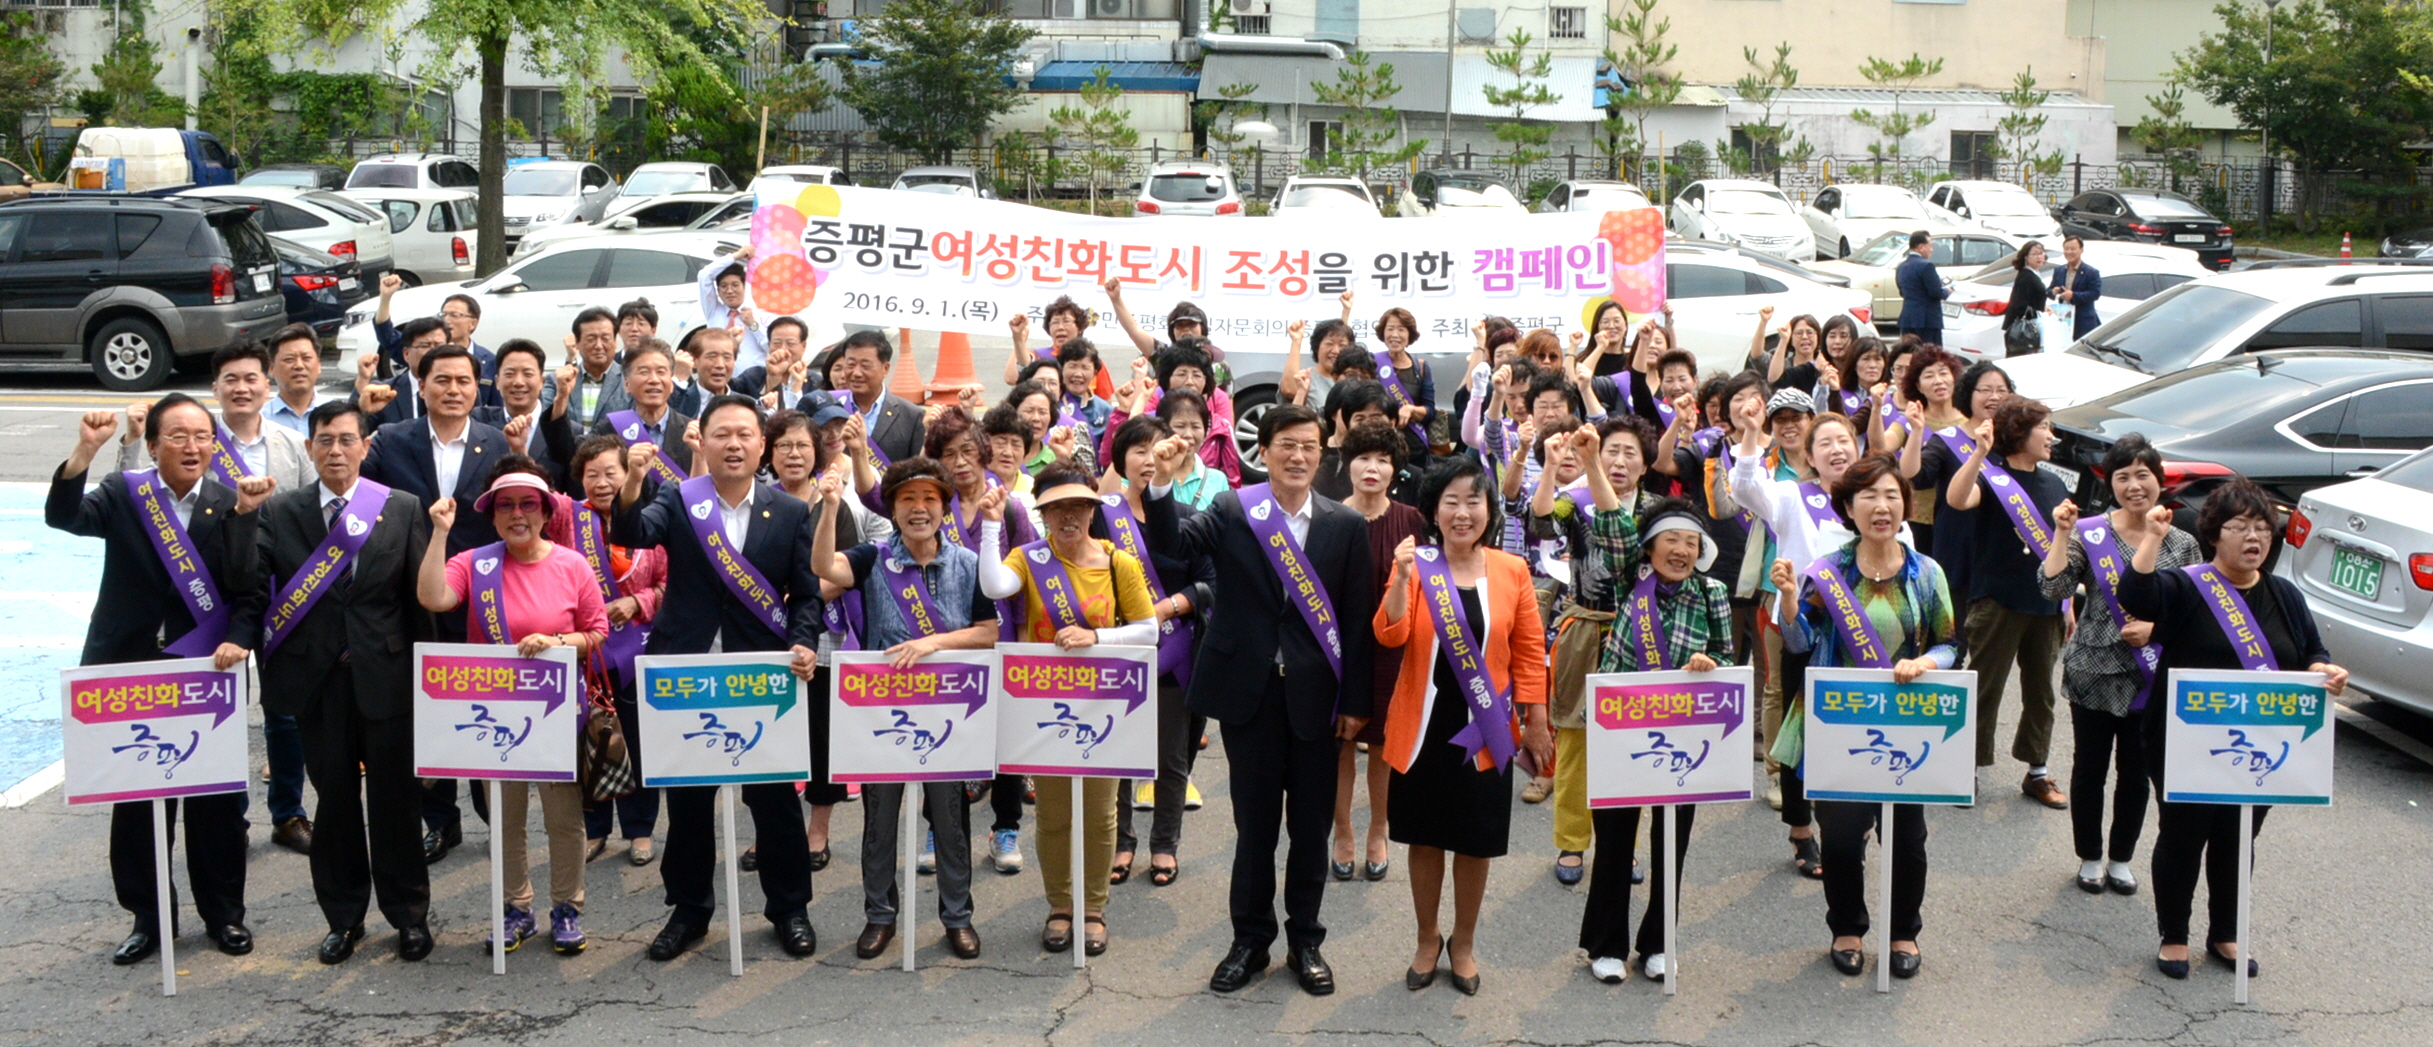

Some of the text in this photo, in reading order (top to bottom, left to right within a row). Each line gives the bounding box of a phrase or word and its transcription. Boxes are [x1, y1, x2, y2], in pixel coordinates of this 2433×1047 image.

[804, 219, 1607, 296] 증평군여성친화도시 조성을 위한 캠페인
[843, 292, 903, 313] 2016.
[912, 299, 930, 316] 9.
[1432, 317, 1468, 338] 주최
[137, 481, 214, 611] 여성친화도시 증평
[2009, 493, 2052, 553] 여성친화도
[271, 546, 344, 631] 여성친화도시
[707, 531, 774, 610] 여성친화도시
[1270, 531, 1342, 659] 여성친화도시 증평
[2334, 561, 2378, 595] 1015
[481, 588, 504, 645] 여성친
[903, 584, 935, 635] 여성친
[1046, 576, 1078, 625] 여성친
[1818, 567, 1878, 661] 여성친화도시
[2200, 571, 2264, 658] 여성친화도시
[1430, 574, 1492, 709] 여성친화도시 증평
[1637, 596, 1662, 671] 여성친화
[77, 679, 231, 713] 여성친화도시
[427, 666, 562, 693] 여성친화도시
[654, 673, 789, 698] 모두가 안녕한
[844, 671, 984, 698] 여성친화도시
[1008, 664, 1143, 692] 여성친화도시
[1601, 690, 1740, 720] 여성친화도시
[1822, 691, 1959, 717] 모두가 안녕한
[2184, 691, 2318, 716] 모두가 안녕한
